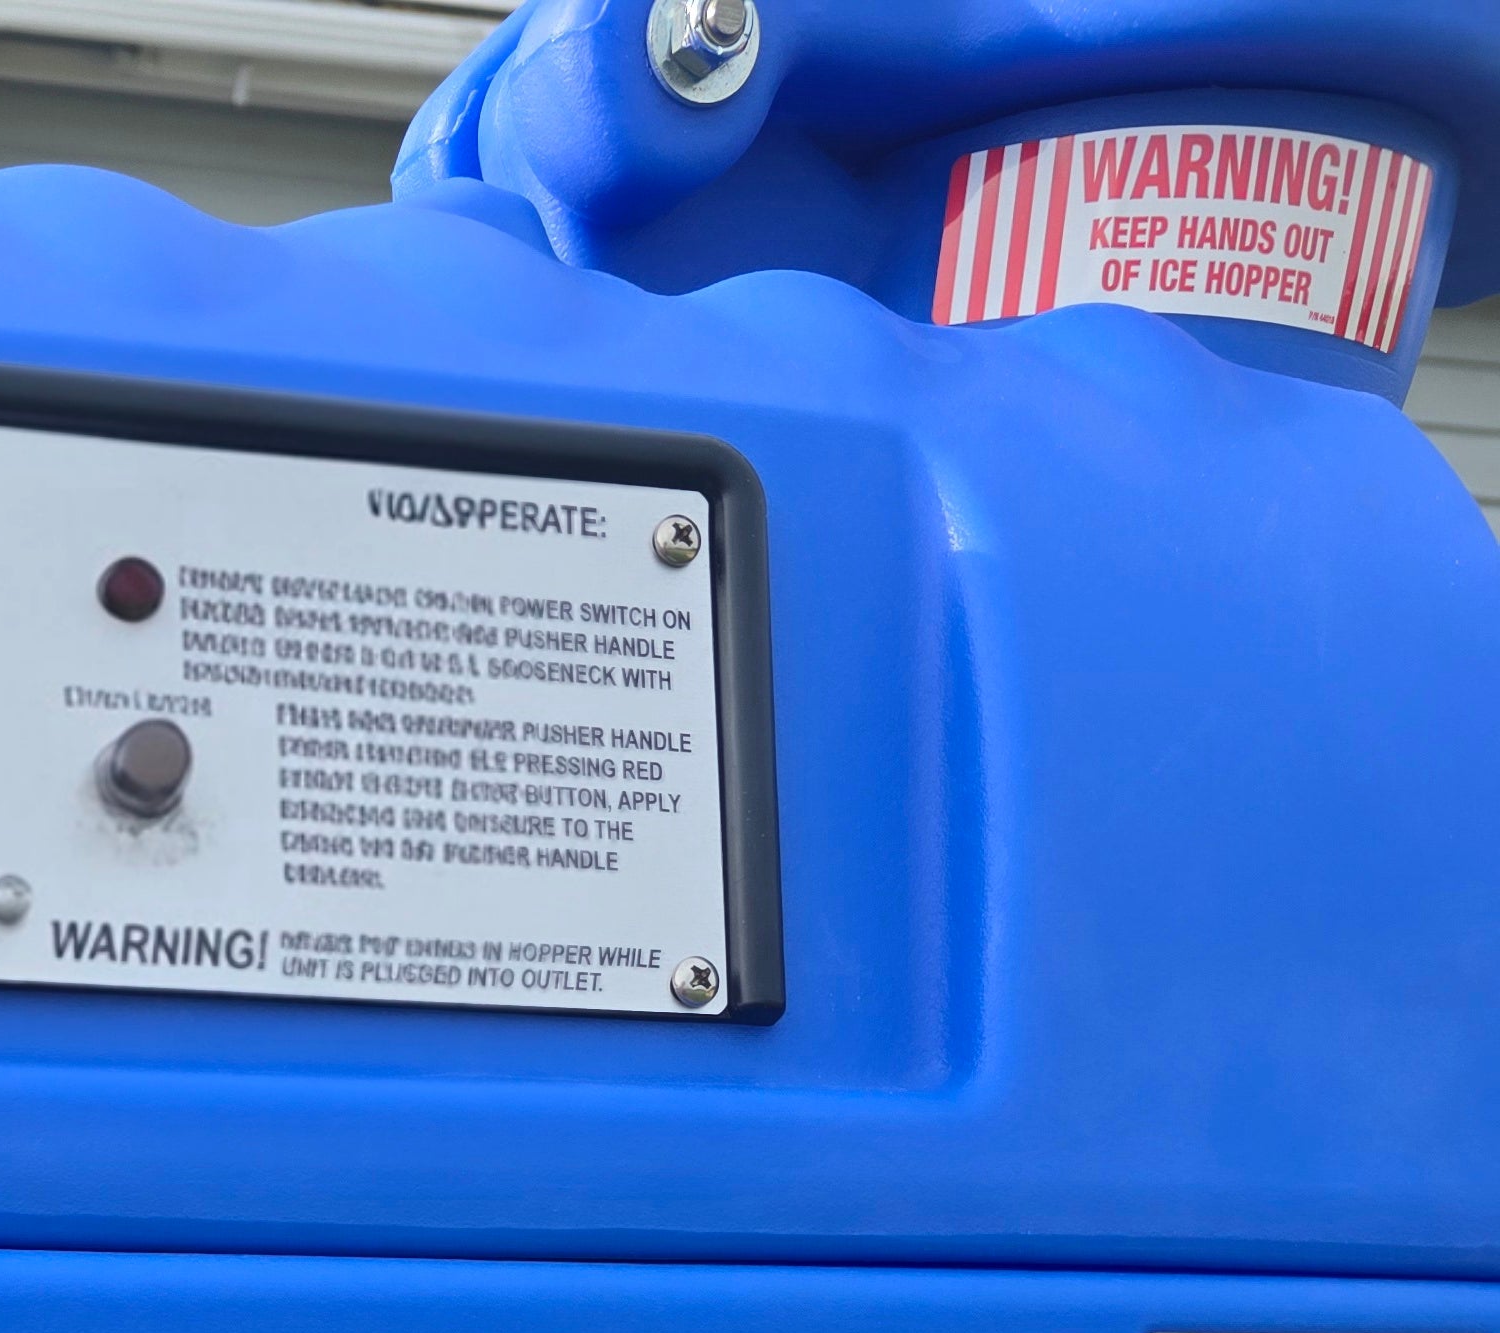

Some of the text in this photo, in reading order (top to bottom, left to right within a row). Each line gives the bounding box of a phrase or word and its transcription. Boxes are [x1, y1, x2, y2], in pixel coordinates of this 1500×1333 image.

[1082, 134, 1358, 215] WARNING!
[1089, 215, 1335, 264] KEEP HANDS OUT
[1101, 259, 1313, 306] OF ICE HOPPER
[579, 602, 656, 628] SWITCH
[662, 609, 691, 631] ON
[505, 627, 587, 653] PUSHER
[594, 635, 675, 660] HANDLE
[621, 667, 672, 691] WITH
[523, 722, 605, 747] PUSHER
[611, 728, 693, 753] HANDLE
[514, 752, 616, 778] PRESSING
[622, 760, 663, 781] RED
[525, 784, 612, 812] BUTTON,
[618, 790, 681, 813] APPLY
[561, 817, 589, 838] TO
[594, 819, 634, 841] THE
[536, 848, 619, 871] HANDLE
[51, 919, 269, 971] WARNING!
[508, 942, 592, 966] HOPPER
[598, 946, 661, 969] WHILE
[467, 967, 515, 988] INTO
[521, 969, 603, 992] OUTLET.
